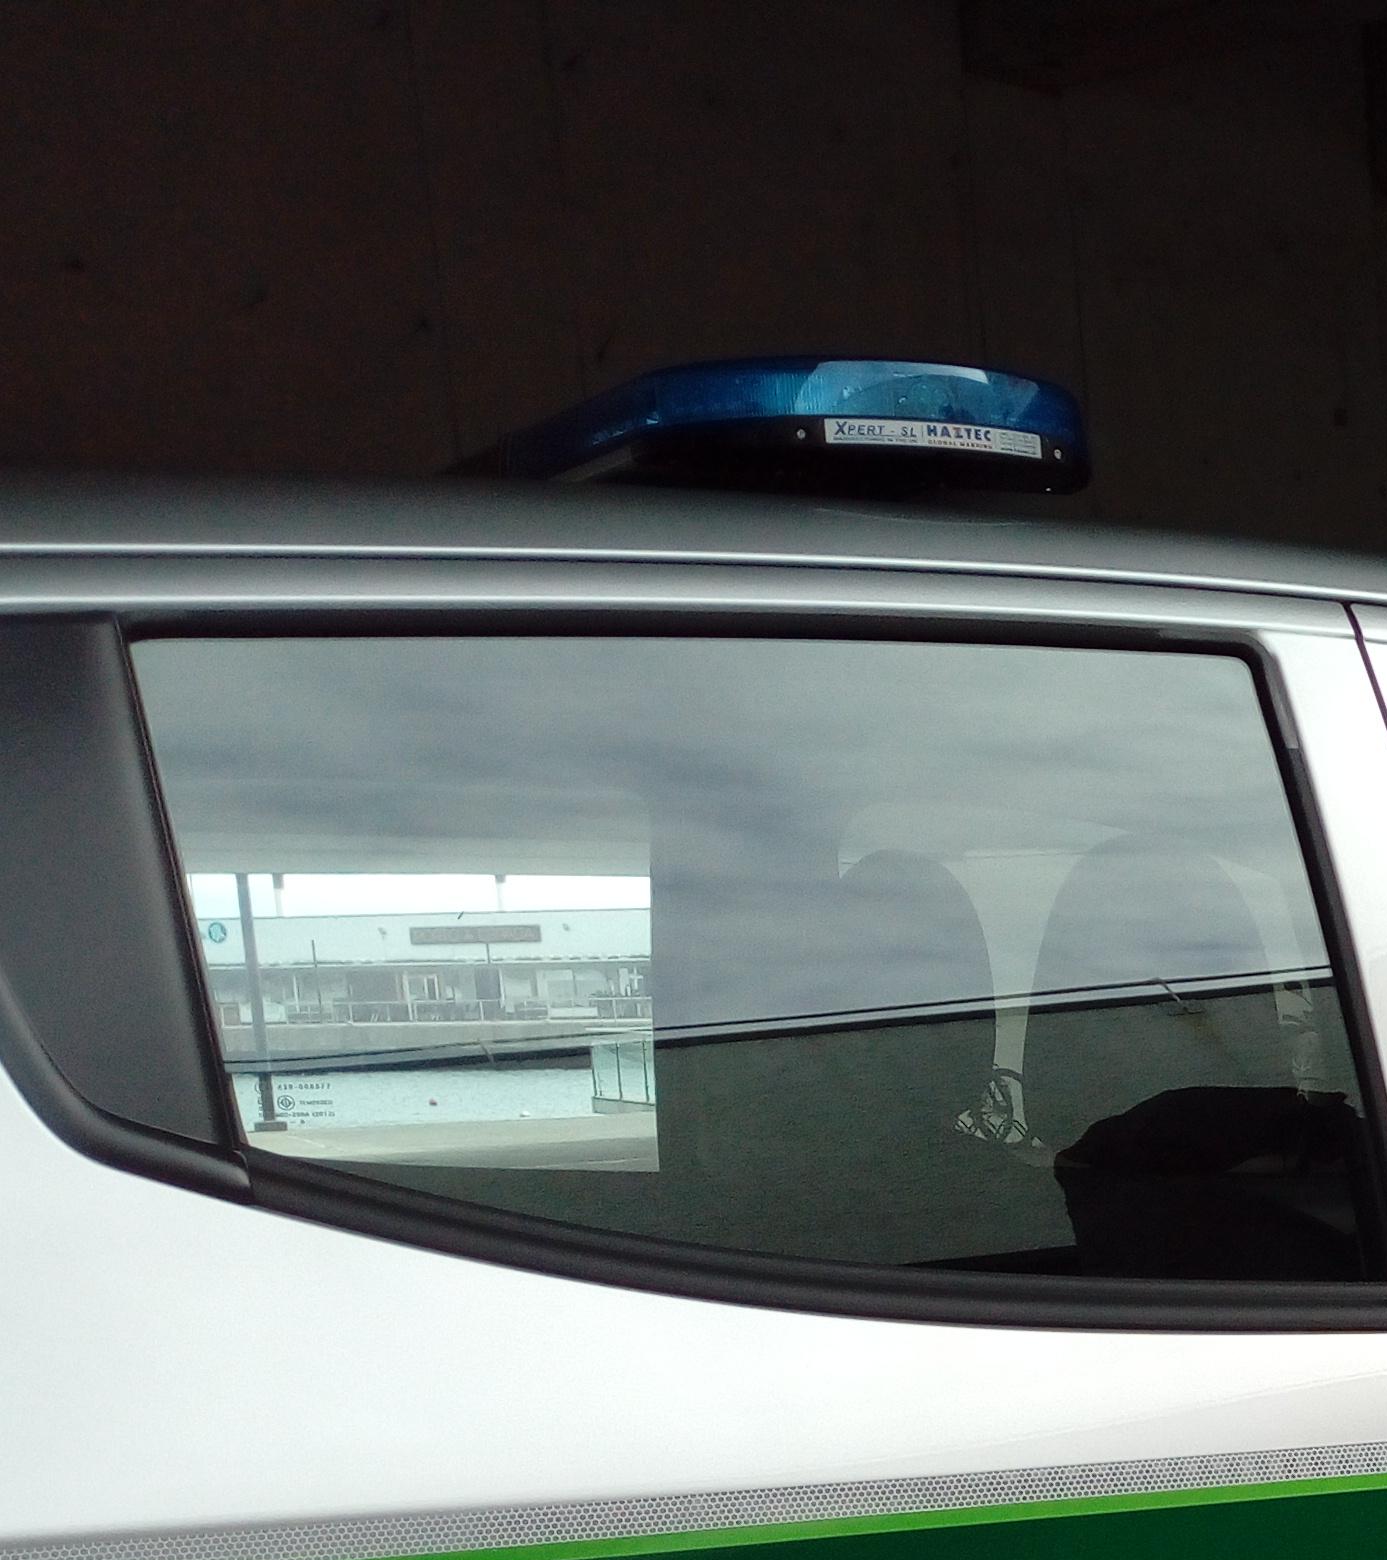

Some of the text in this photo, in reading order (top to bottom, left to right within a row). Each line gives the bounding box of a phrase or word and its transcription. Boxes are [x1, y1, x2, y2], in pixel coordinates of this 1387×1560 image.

[836, 421, 885, 436] XPERT
[900, 426, 917, 437] SL
[927, 425, 991, 441] HAZTEC
